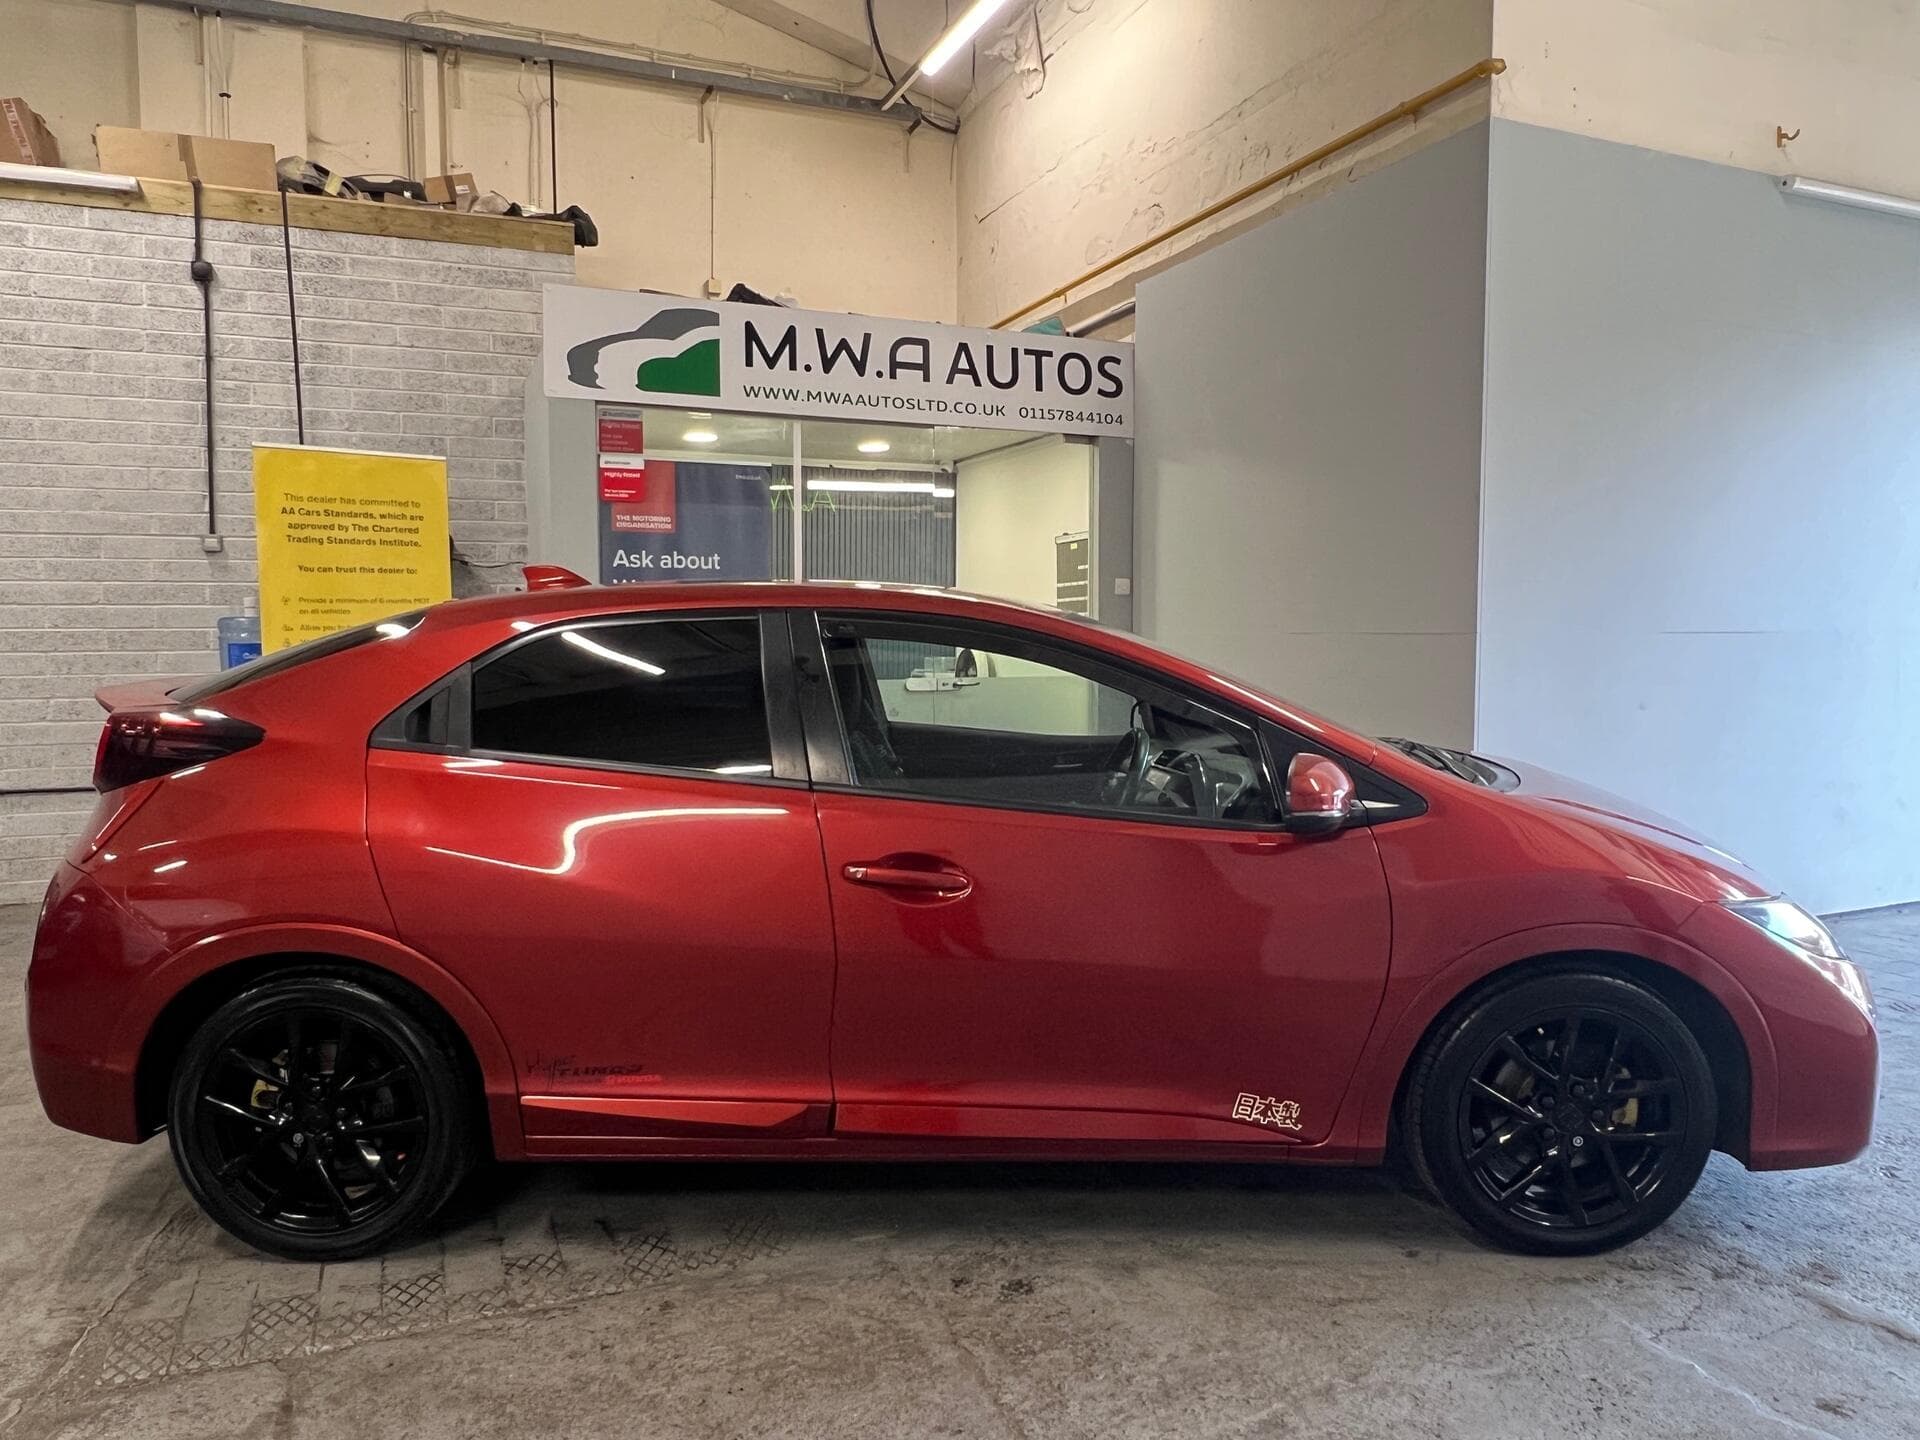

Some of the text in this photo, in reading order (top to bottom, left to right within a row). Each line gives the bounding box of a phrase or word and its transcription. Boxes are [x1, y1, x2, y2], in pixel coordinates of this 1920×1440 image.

[945, 341, 1124, 399] AUTOS
[743, 384, 1124, 426] WWW.MWAAUTOSLTD.CO.UK 01157844104
[284, 492, 303, 503] This
[307, 495, 337, 504] dealer
[340, 496, 357, 505] has
[359, 498, 409, 508] committed
[281, 507, 296, 515] AA
[298, 508, 321, 517] Cars
[379, 512, 407, 521] which
[288, 522, 420, 534] approved by The Chartered
[616, 522, 672, 530] ORGANISATION
[286, 535, 422, 548] Trading Standards Institute.
[612, 550, 721, 570] Ask about
[298, 564, 315, 573] You
[335, 566, 357, 574] trust
[359, 566, 375, 574] this
